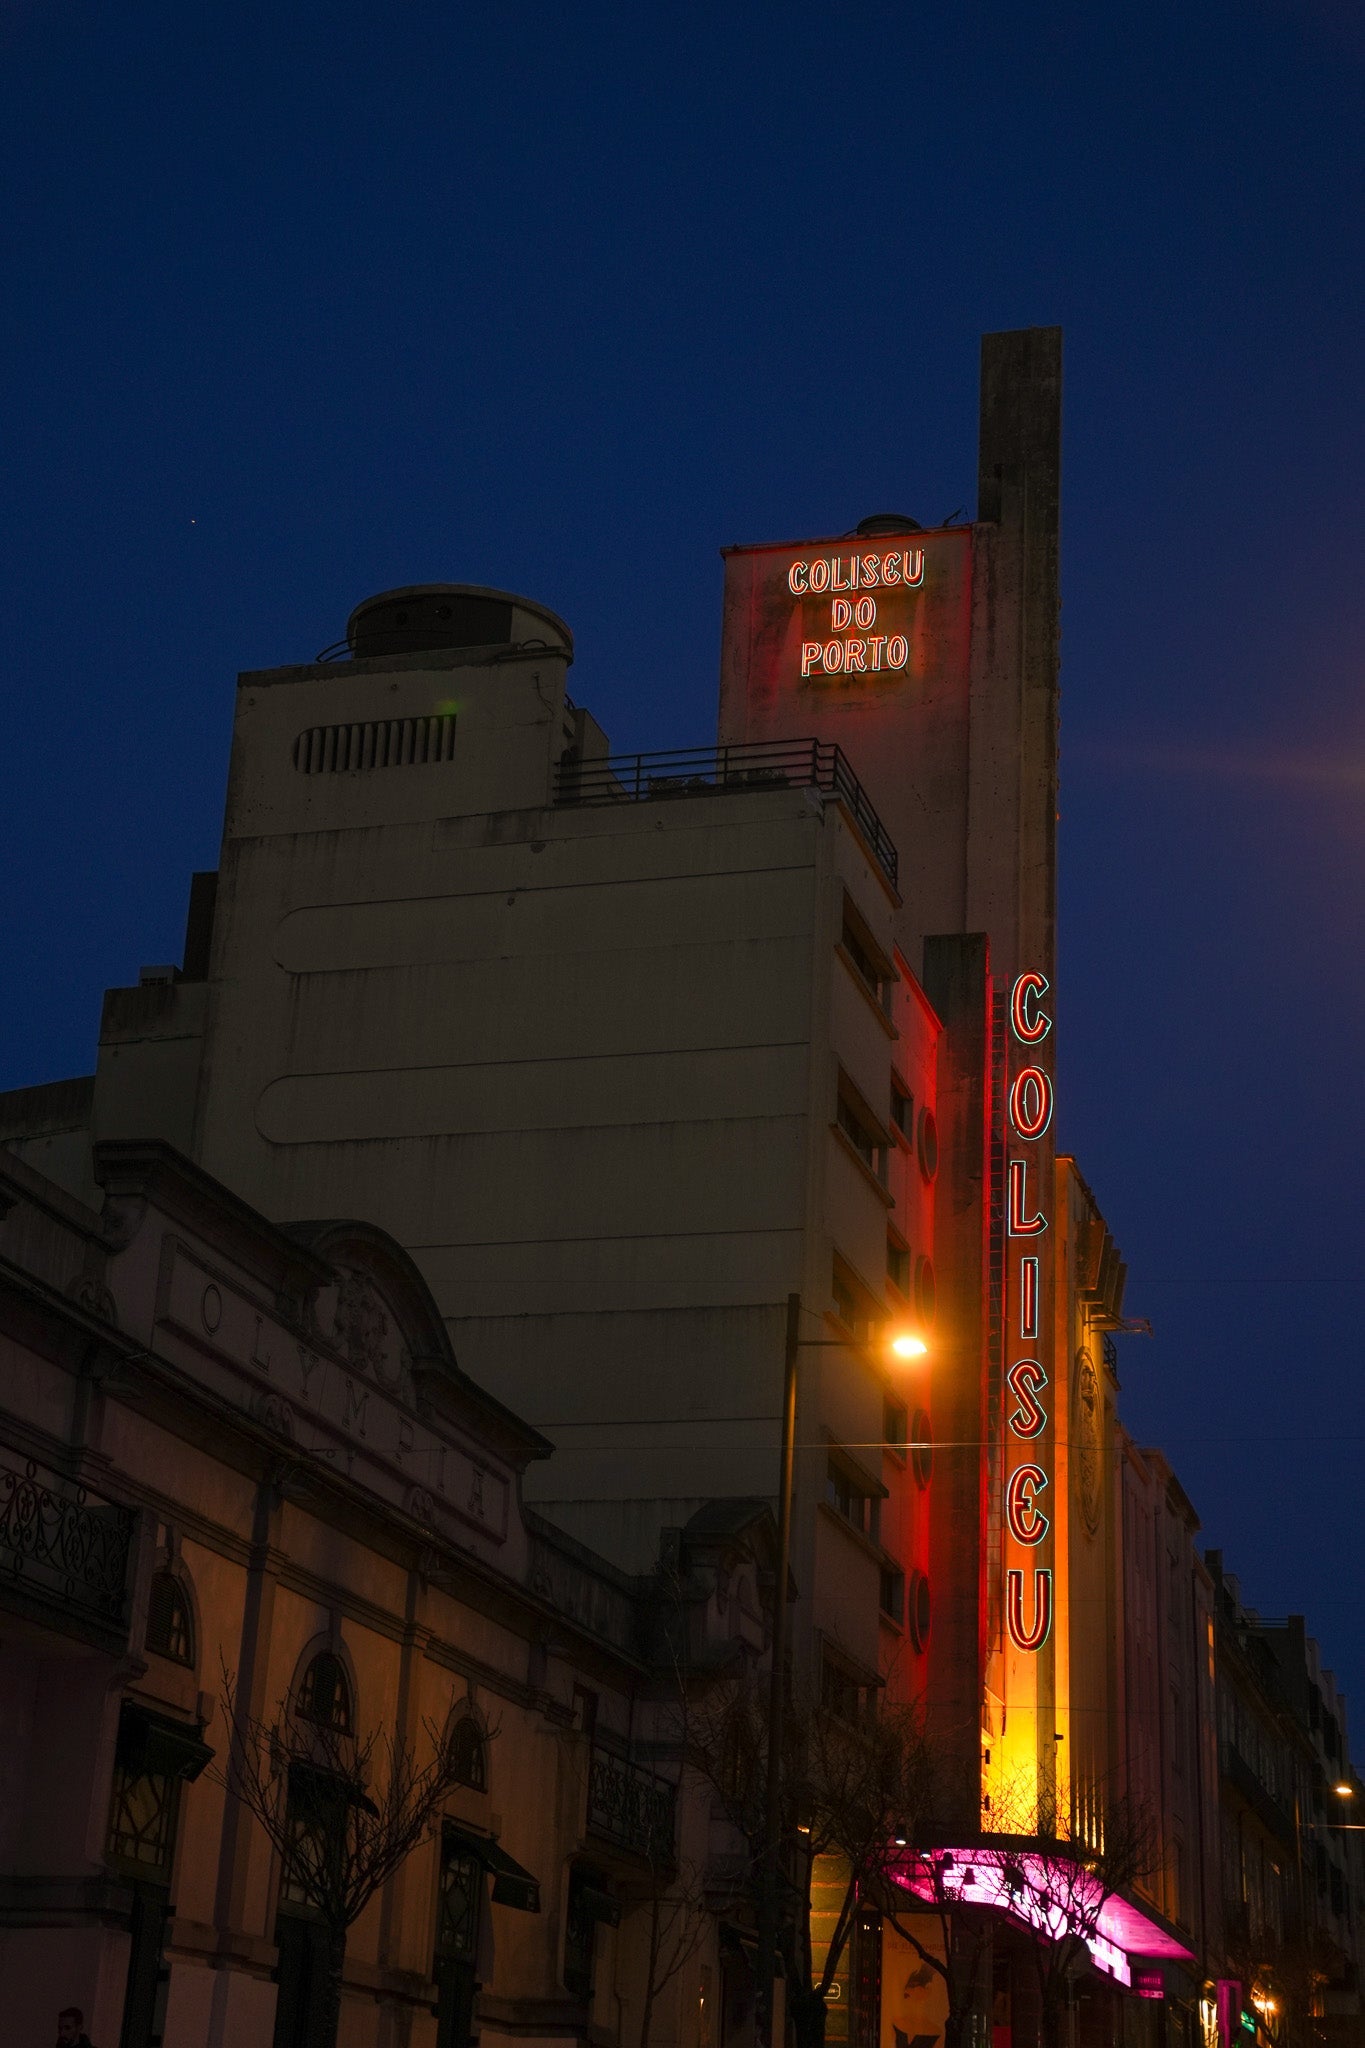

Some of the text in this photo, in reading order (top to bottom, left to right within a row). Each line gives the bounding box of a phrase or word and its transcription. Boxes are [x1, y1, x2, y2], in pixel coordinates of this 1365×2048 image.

[789, 549, 924, 595] COLISEU
[832, 596, 876, 632] DO
[802, 635, 908, 676] PORTO
[1007, 971, 1053, 1653] COLISEU
[201, 1283, 486, 1519] OLYMPIA
